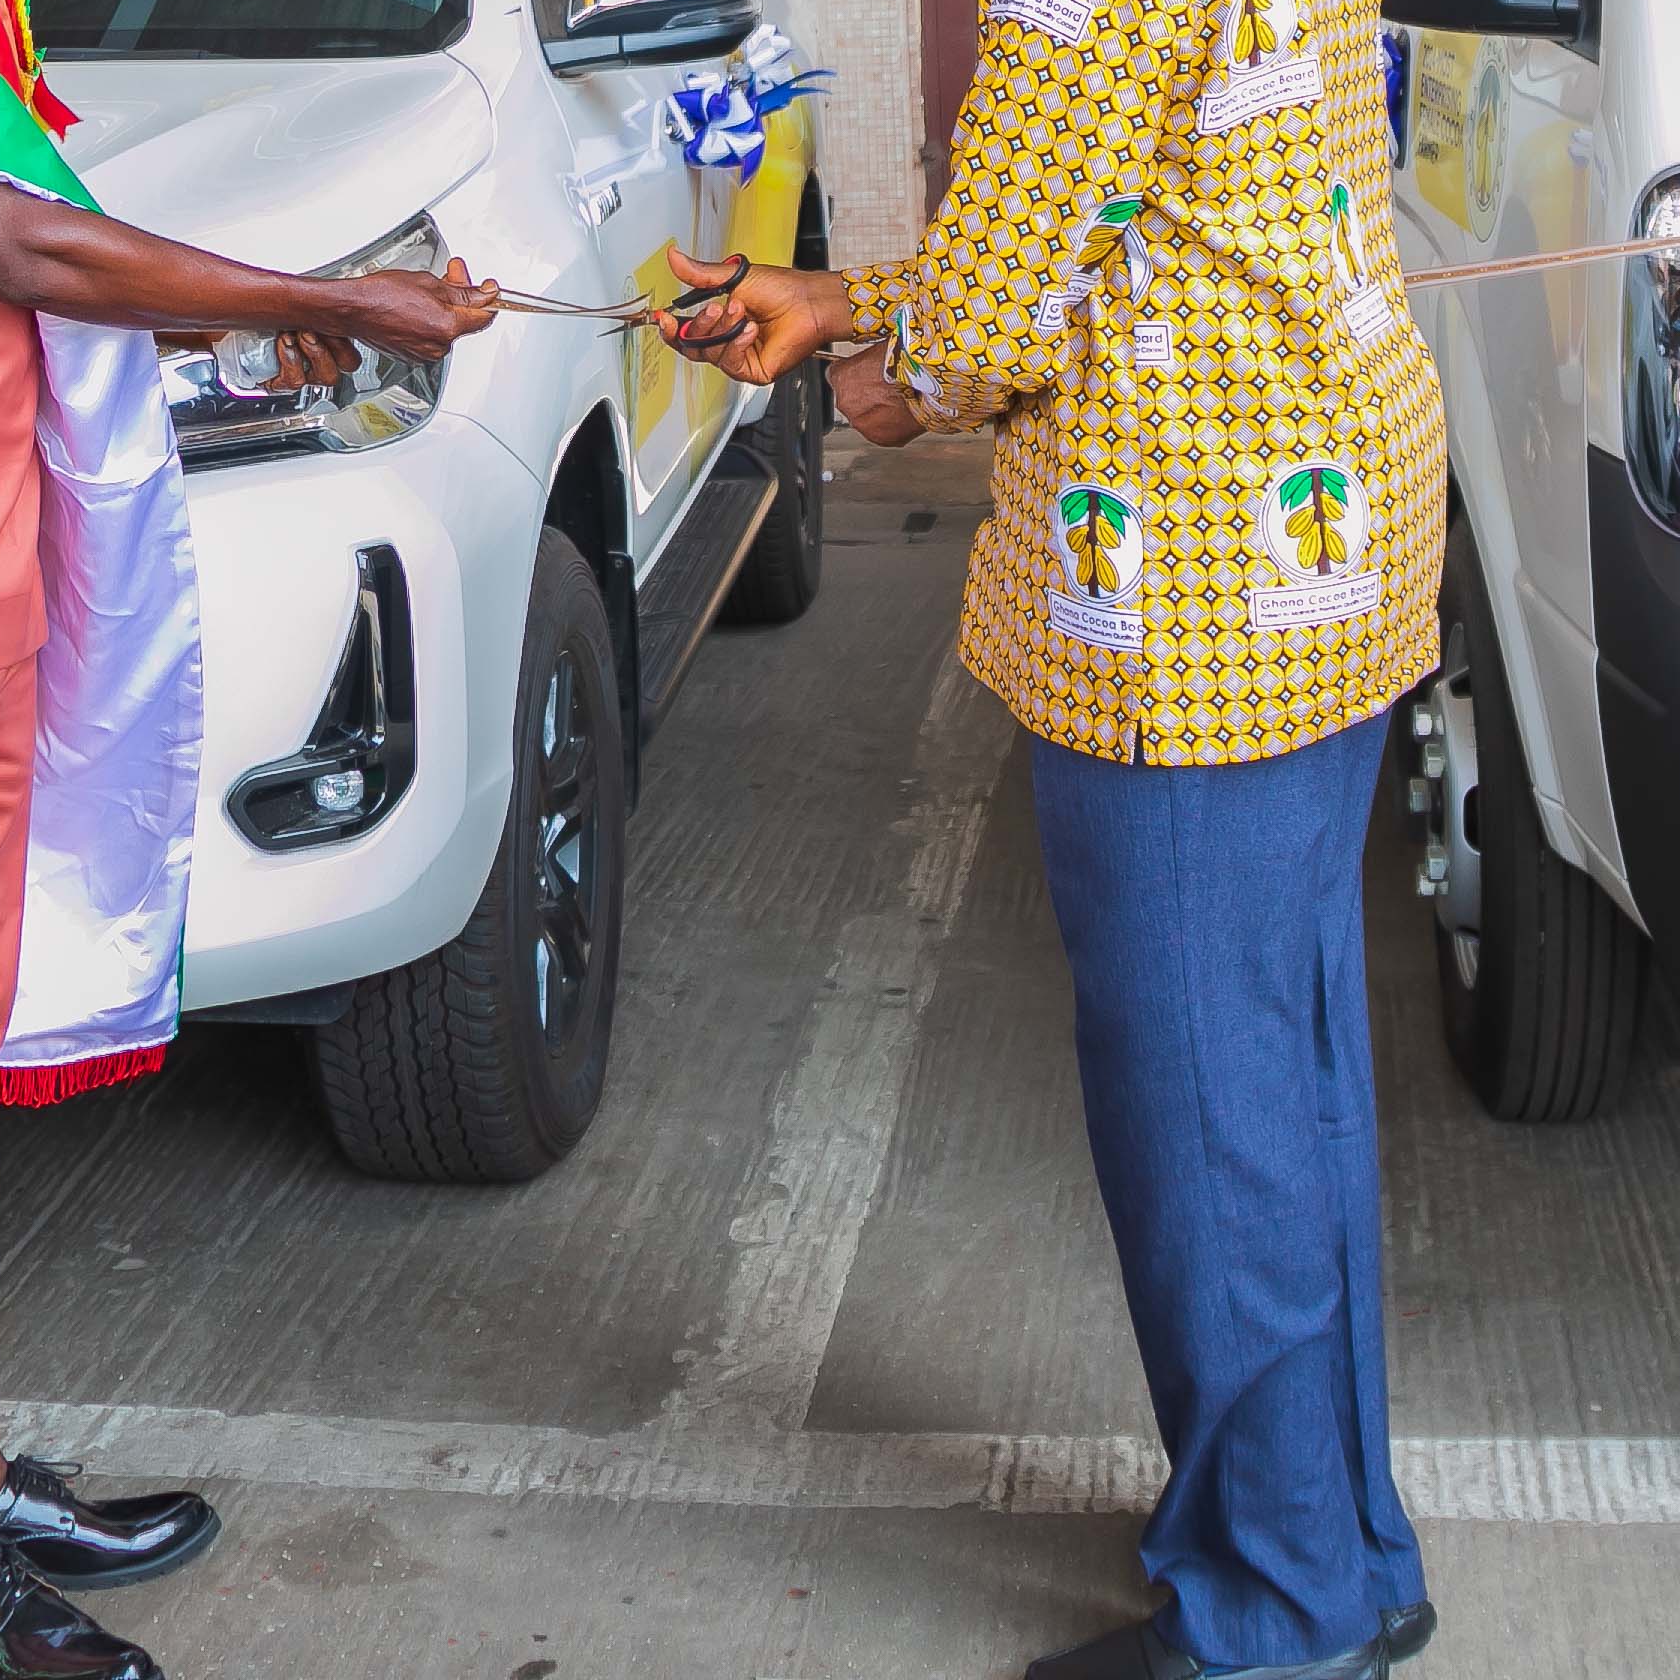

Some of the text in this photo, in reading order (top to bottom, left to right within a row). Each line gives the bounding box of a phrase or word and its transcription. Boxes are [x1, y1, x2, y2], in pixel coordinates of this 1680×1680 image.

[1240, 80, 1276, 99] Cocoa
[1279, 69, 1315, 85] Board
[1260, 582, 1376, 610] Ghana Cocoa Board
[1053, 601, 1080, 621] Ghana
[1081, 612, 1117, 630] Cocoa
